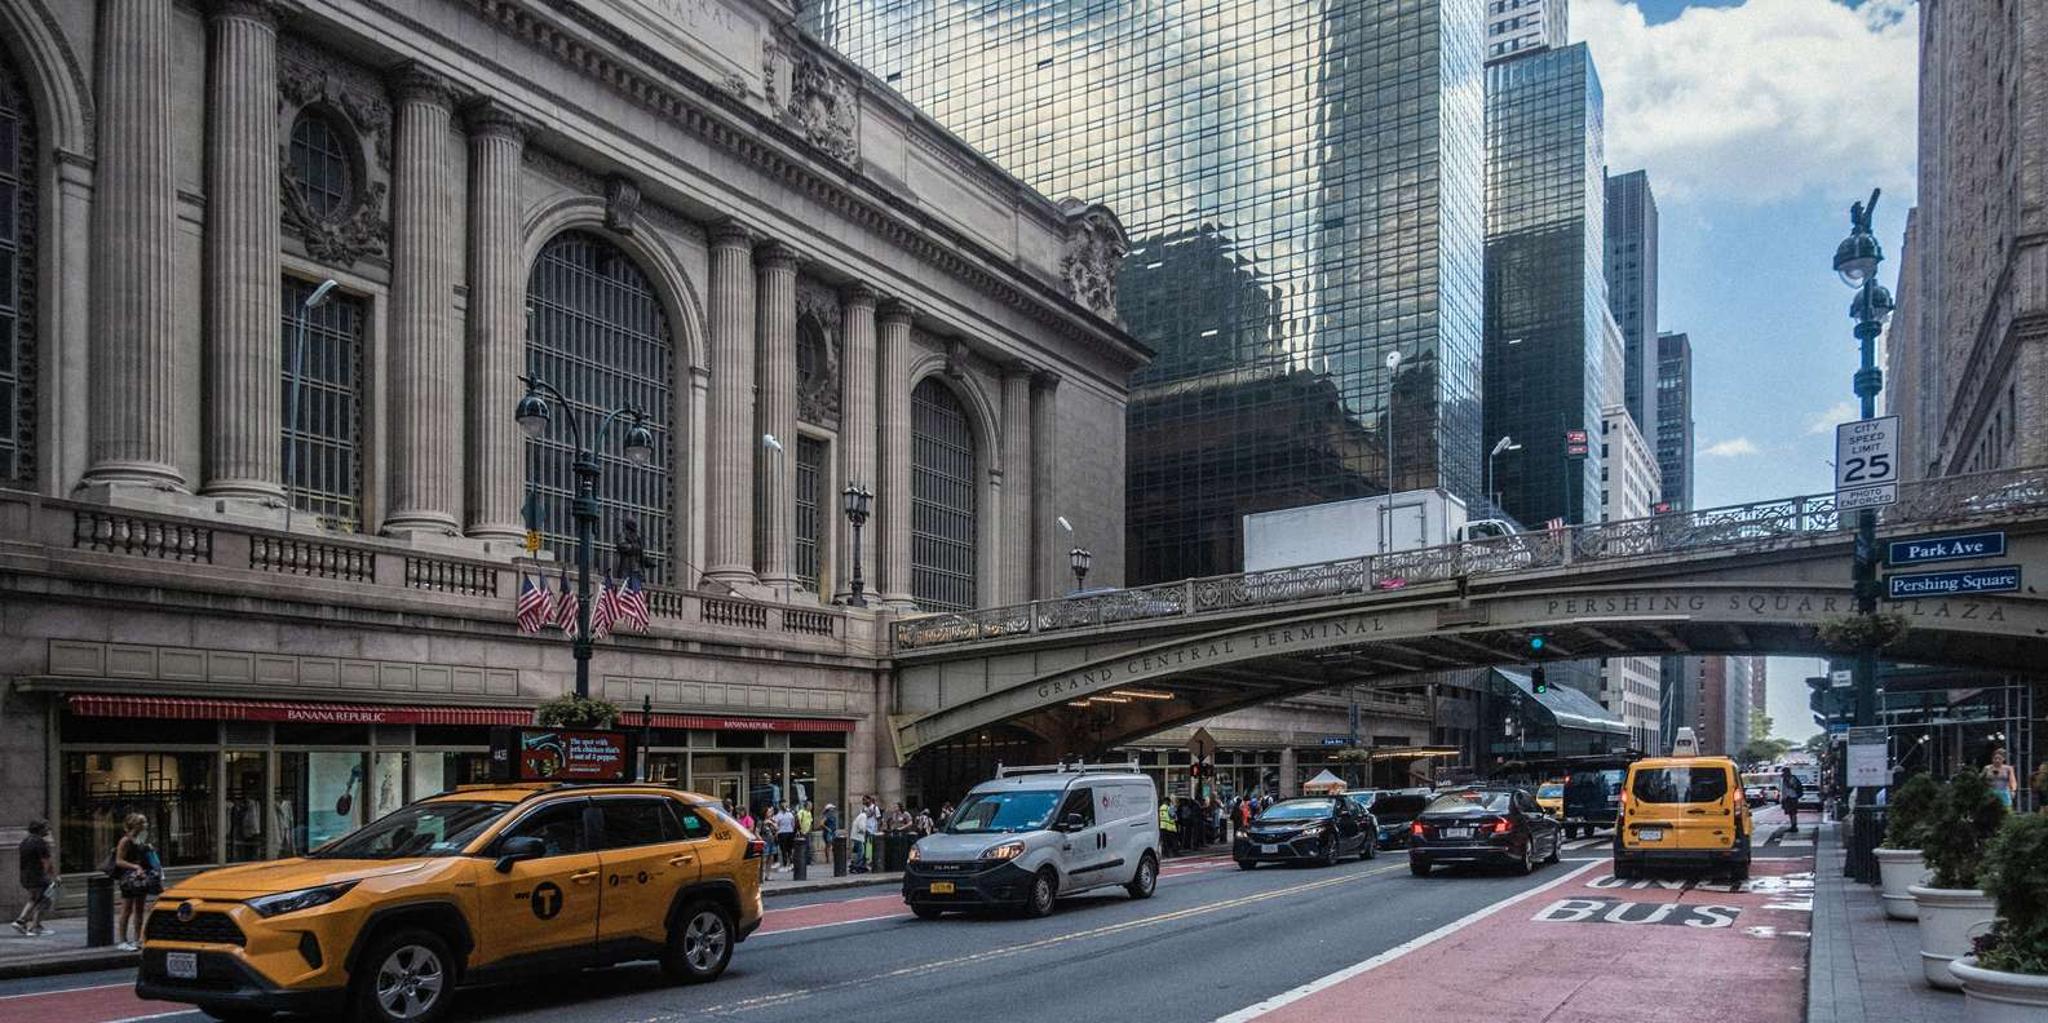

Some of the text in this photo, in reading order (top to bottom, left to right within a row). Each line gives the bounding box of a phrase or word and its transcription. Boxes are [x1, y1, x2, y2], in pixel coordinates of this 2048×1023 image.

[1854, 423, 1880, 434] CITY
[1849, 432, 1885, 445] SPEED
[1852, 443, 1880, 454] LIMIT
[1844, 454, 1890, 482] 25
[1850, 488, 1882, 498] PHOTO
[1841, 495, 1891, 507] ENFORCED
[1908, 541, 1984, 558] Park Ave
[1893, 574, 2015, 592] Pershing Square
[1549, 597, 1705, 614] PERSHING
[1038, 617, 1384, 698] GRAND CENTRAL TERMINAL
[288, 710, 385, 721] BANANA REPUBLIC
[1530, 899, 1741, 928] BUS
